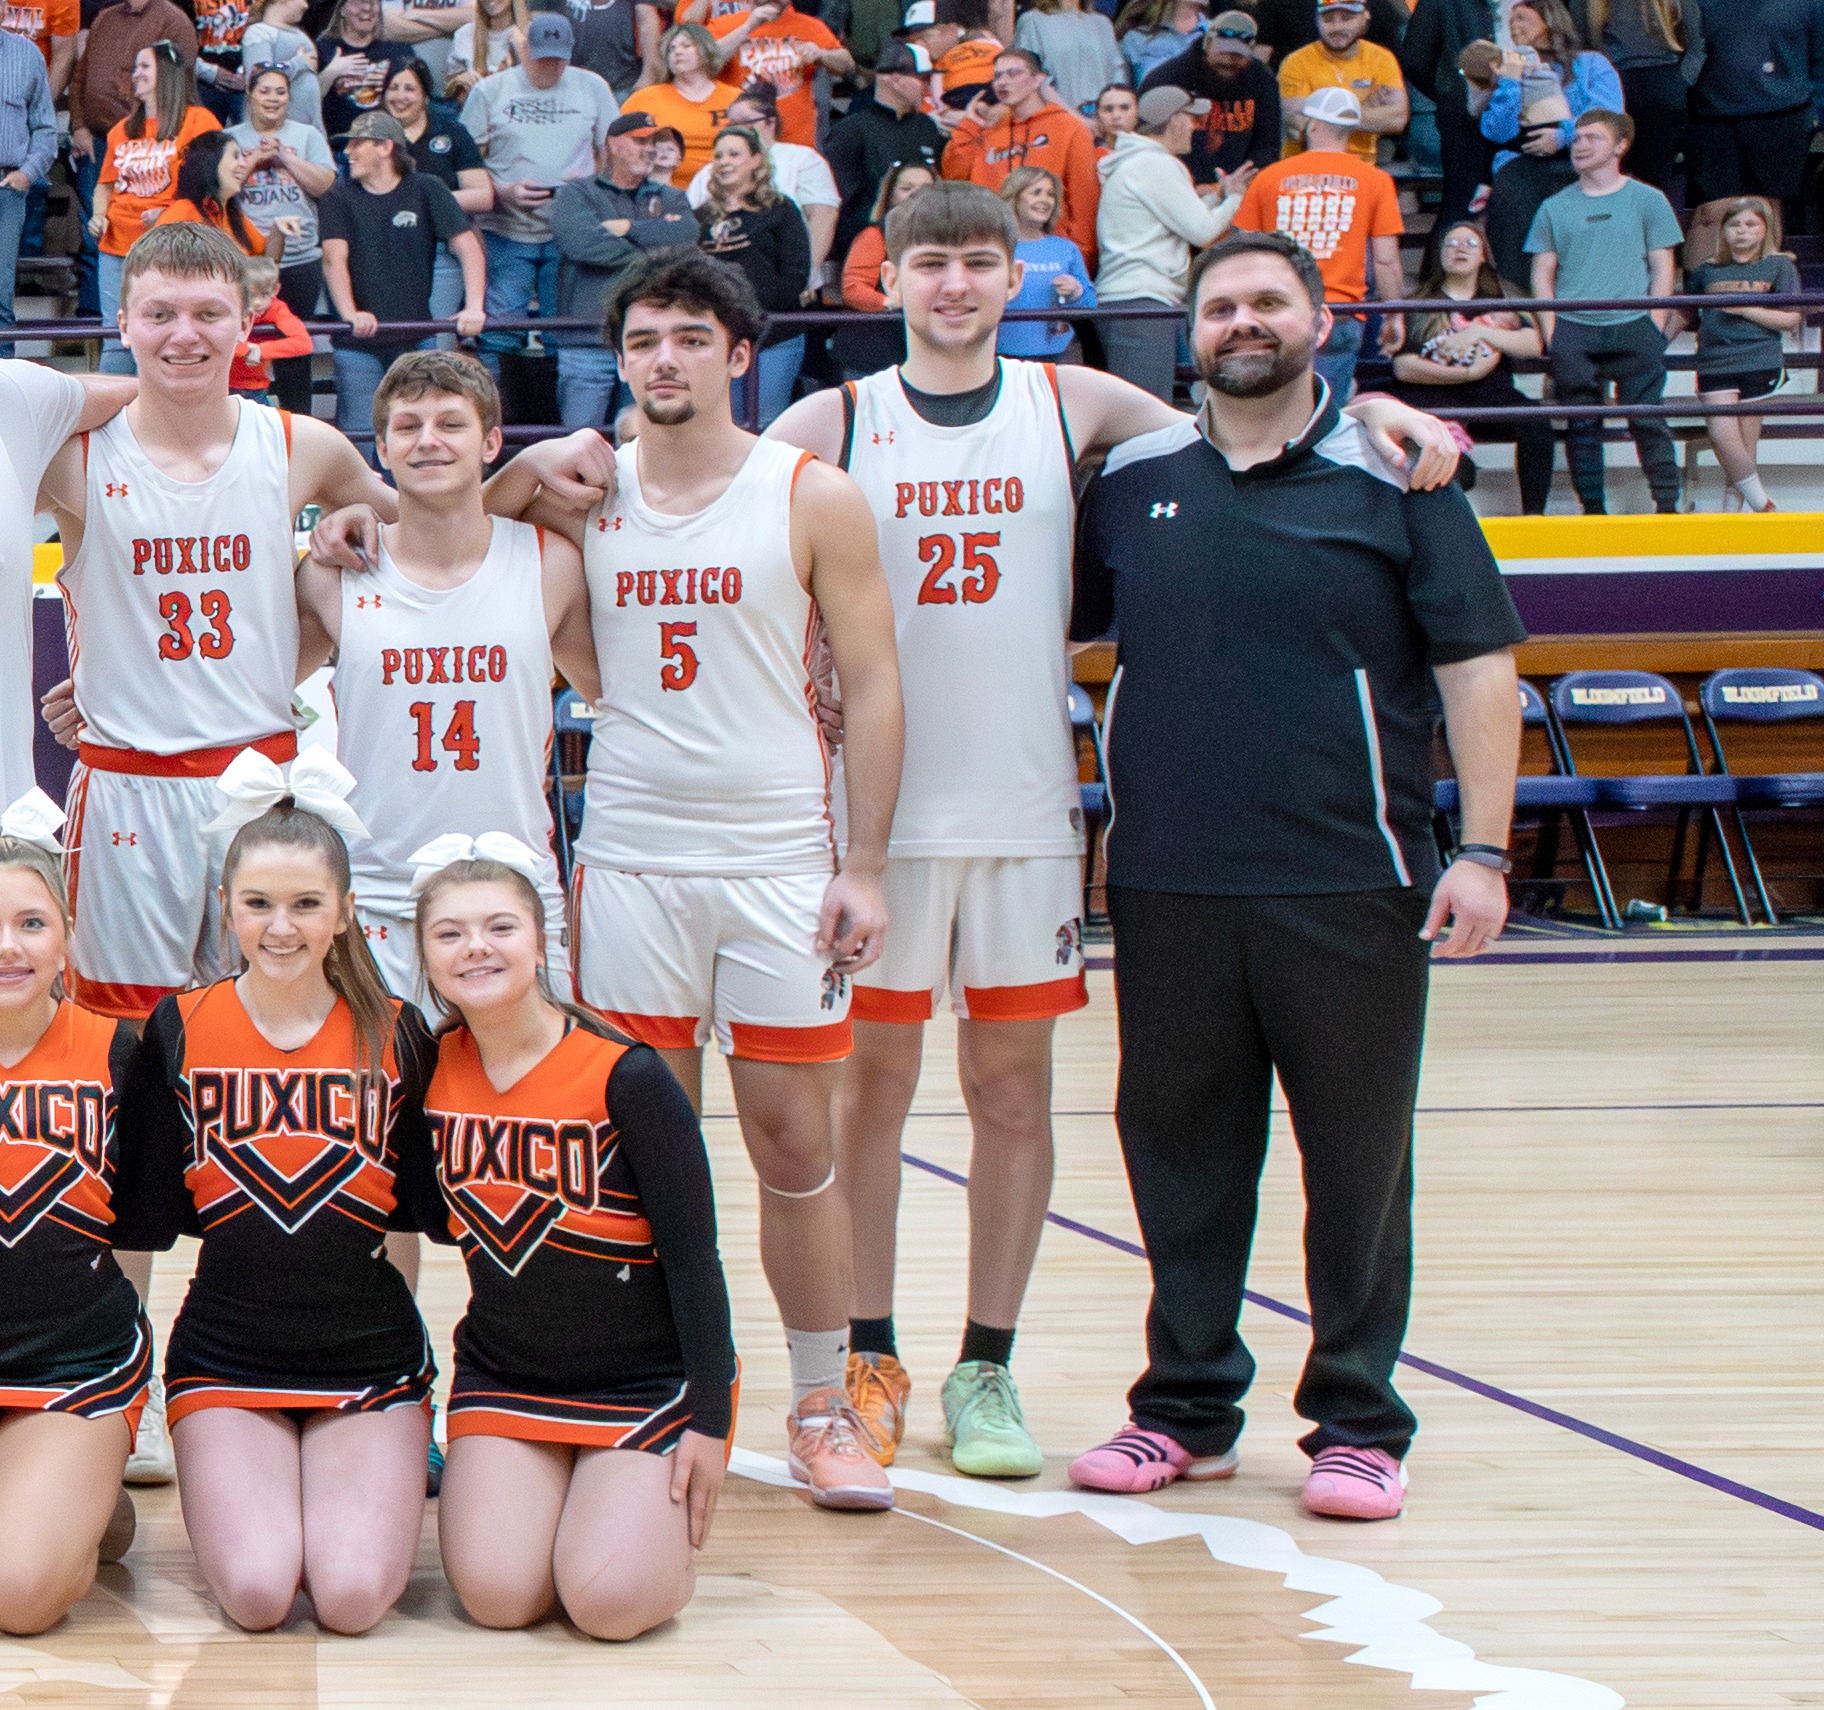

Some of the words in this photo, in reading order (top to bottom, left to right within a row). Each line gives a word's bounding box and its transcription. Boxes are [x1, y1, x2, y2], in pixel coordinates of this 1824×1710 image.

[242, 186, 301, 206] NDIANS
[895, 476, 1025, 518] PUXICO
[132, 534, 252, 576] PUXICO
[917, 531, 1001, 606] 25
[616, 567, 743, 607] PUXICO
[157, 589, 236, 661] 33
[381, 644, 508, 685] PUXICO
[657, 621, 700, 691] 5
[409, 700, 481, 772] 14
[190, 1069, 390, 1169] PUXICO
